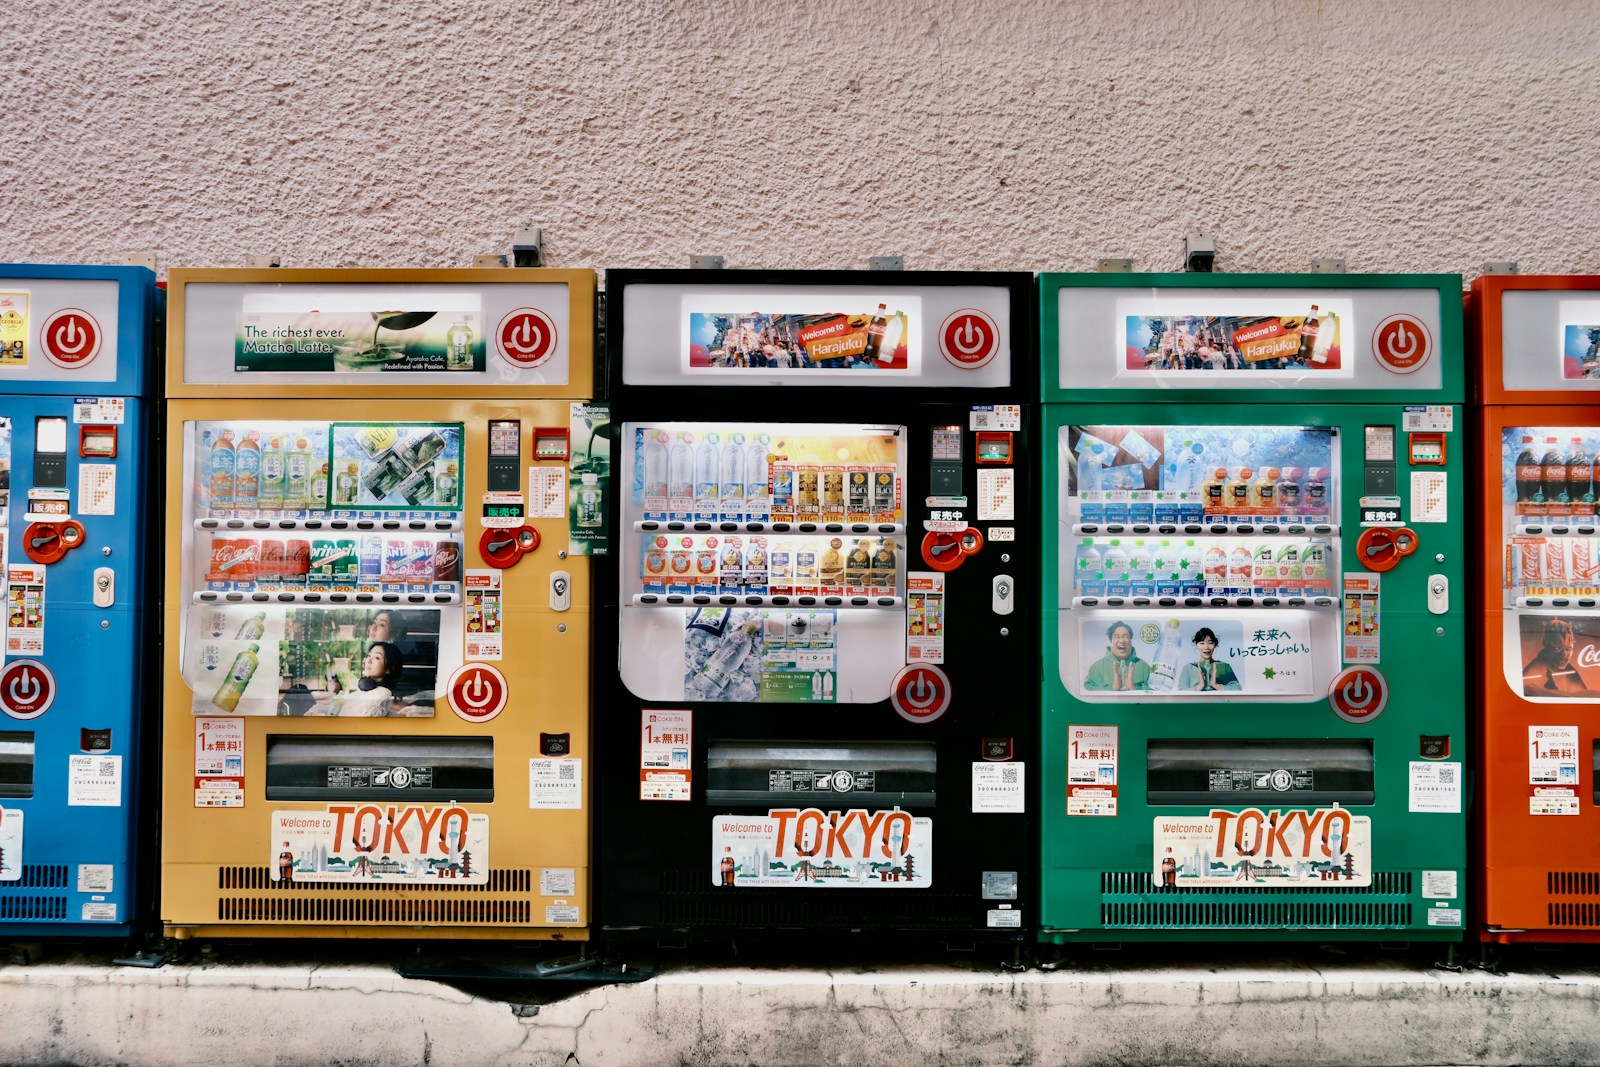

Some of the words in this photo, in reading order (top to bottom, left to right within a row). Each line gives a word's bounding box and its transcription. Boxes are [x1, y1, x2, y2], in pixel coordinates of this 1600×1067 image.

[244, 325, 268, 338] The
[272, 325, 313, 338] richest
[316, 328, 345, 338] ever.
[801, 325, 835, 341] Welcome
[836, 323, 844, 331] to
[1236, 327, 1269, 342] Welcome
[1269, 325, 1277, 333] to
[243, 341, 293, 354] Matcha
[297, 341, 333, 354] Latte.
[812, 338, 862, 356] Harajuku
[1247, 339, 1296, 357] Harajuku
[34, 502, 65, 513] 販売中
[488, 507, 520, 517] 販売中
[931, 511, 962, 520] 販売中
[1365, 512, 1396, 521] 販売中
[1253, 628, 1291, 642] 未来へ
[1230, 643, 1310, 657] いってらっしゃい。
[198, 732, 242, 752] 1本無料!
[645, 725, 688, 744] 1本無料!
[1071, 740, 1114, 760] 1本無料!
[1531, 741, 1575, 760] 1本無料!
[280, 818, 320, 828] Welcome
[322, 819, 331, 828] to
[329, 806, 469, 854] TOKYO
[721, 823, 762, 833] Welcome
[764, 824, 772, 833] to
[1162, 823, 1203, 834] Welcome
[1204, 824, 1213, 833] to
[771, 811, 912, 858] TOKYO
[1212, 811, 1351, 857] TOKYO
